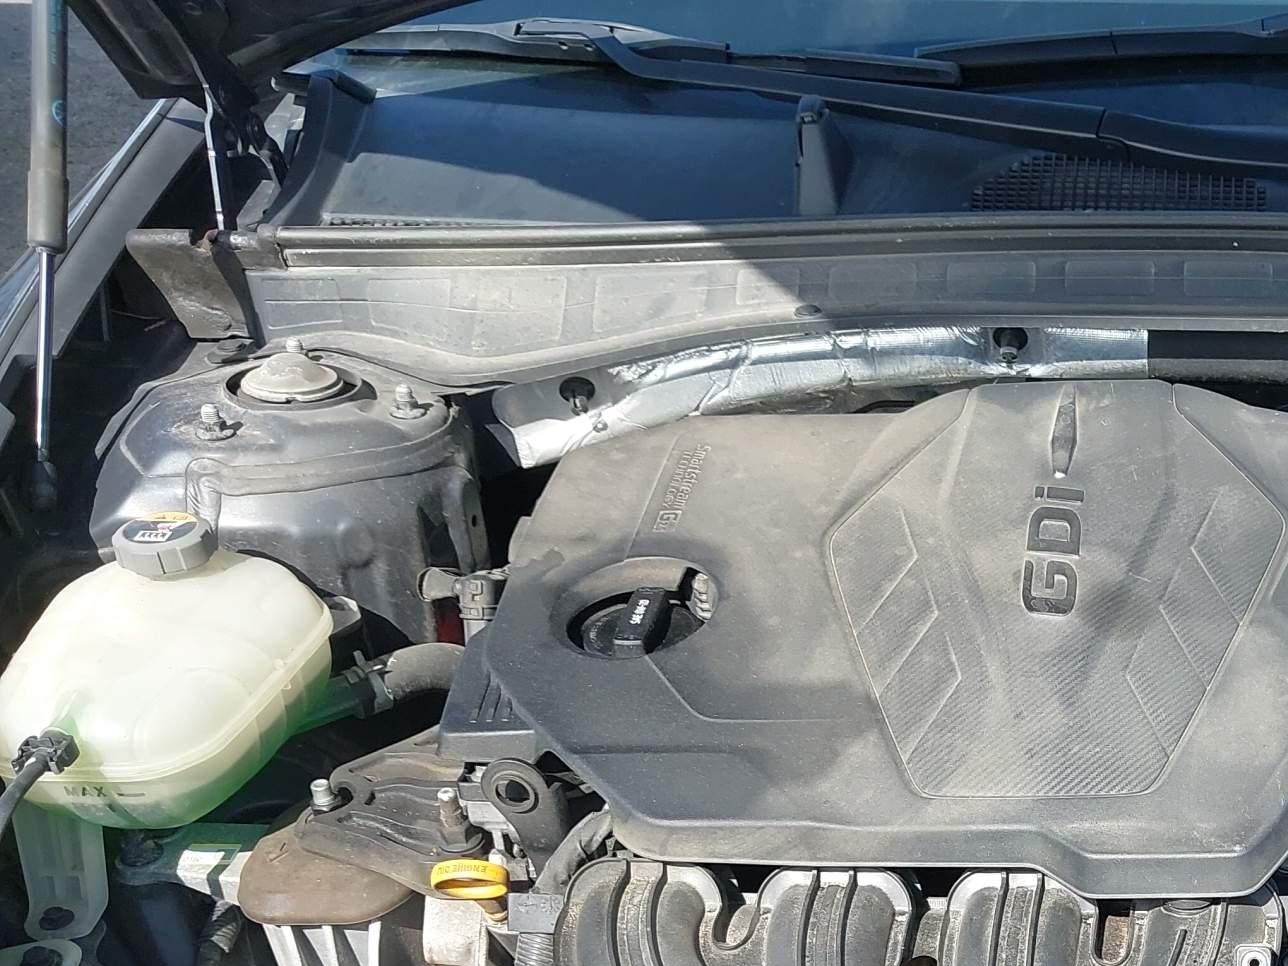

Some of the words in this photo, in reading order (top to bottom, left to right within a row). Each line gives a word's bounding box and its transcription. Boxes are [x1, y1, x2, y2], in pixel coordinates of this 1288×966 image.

[672, 443, 711, 510] Smartstream
[1022, 485, 1086, 616] GDi
[63, 785, 107, 798] MAX
[452, 863, 489, 873] ENGINE
